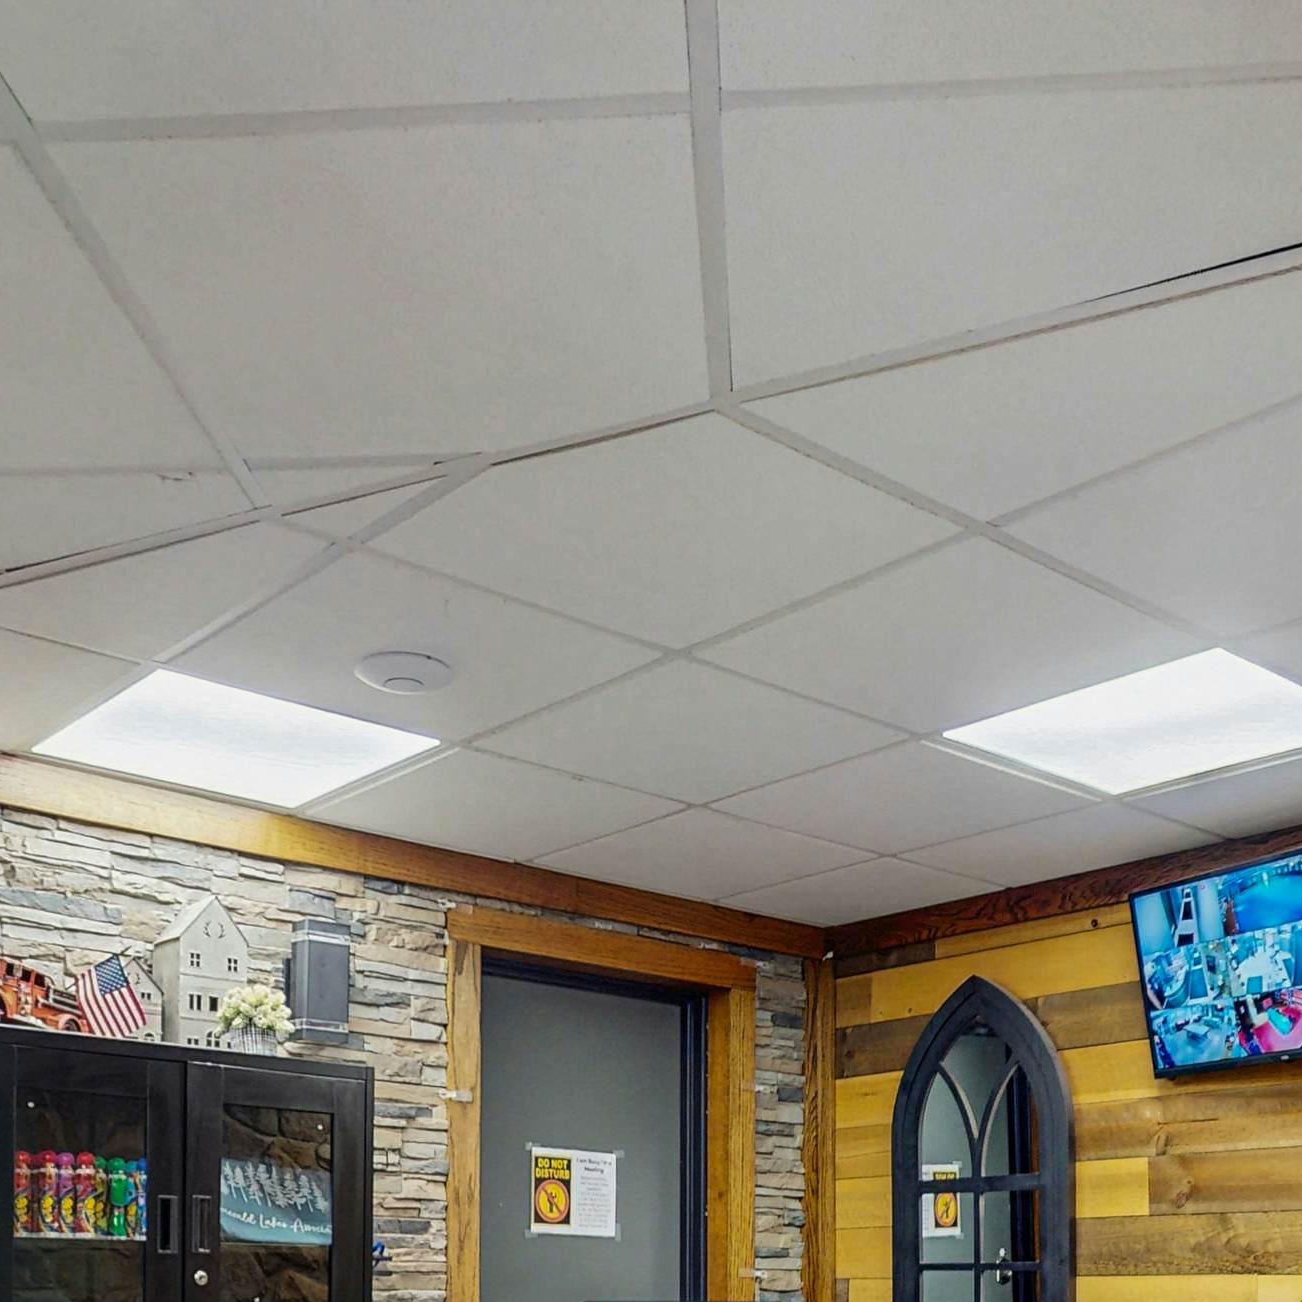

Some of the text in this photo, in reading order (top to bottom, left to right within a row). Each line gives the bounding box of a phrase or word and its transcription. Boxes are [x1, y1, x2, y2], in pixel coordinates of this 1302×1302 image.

[538, 1158, 568, 1169] DO NOT
[535, 1167, 570, 1180] DISTURB
